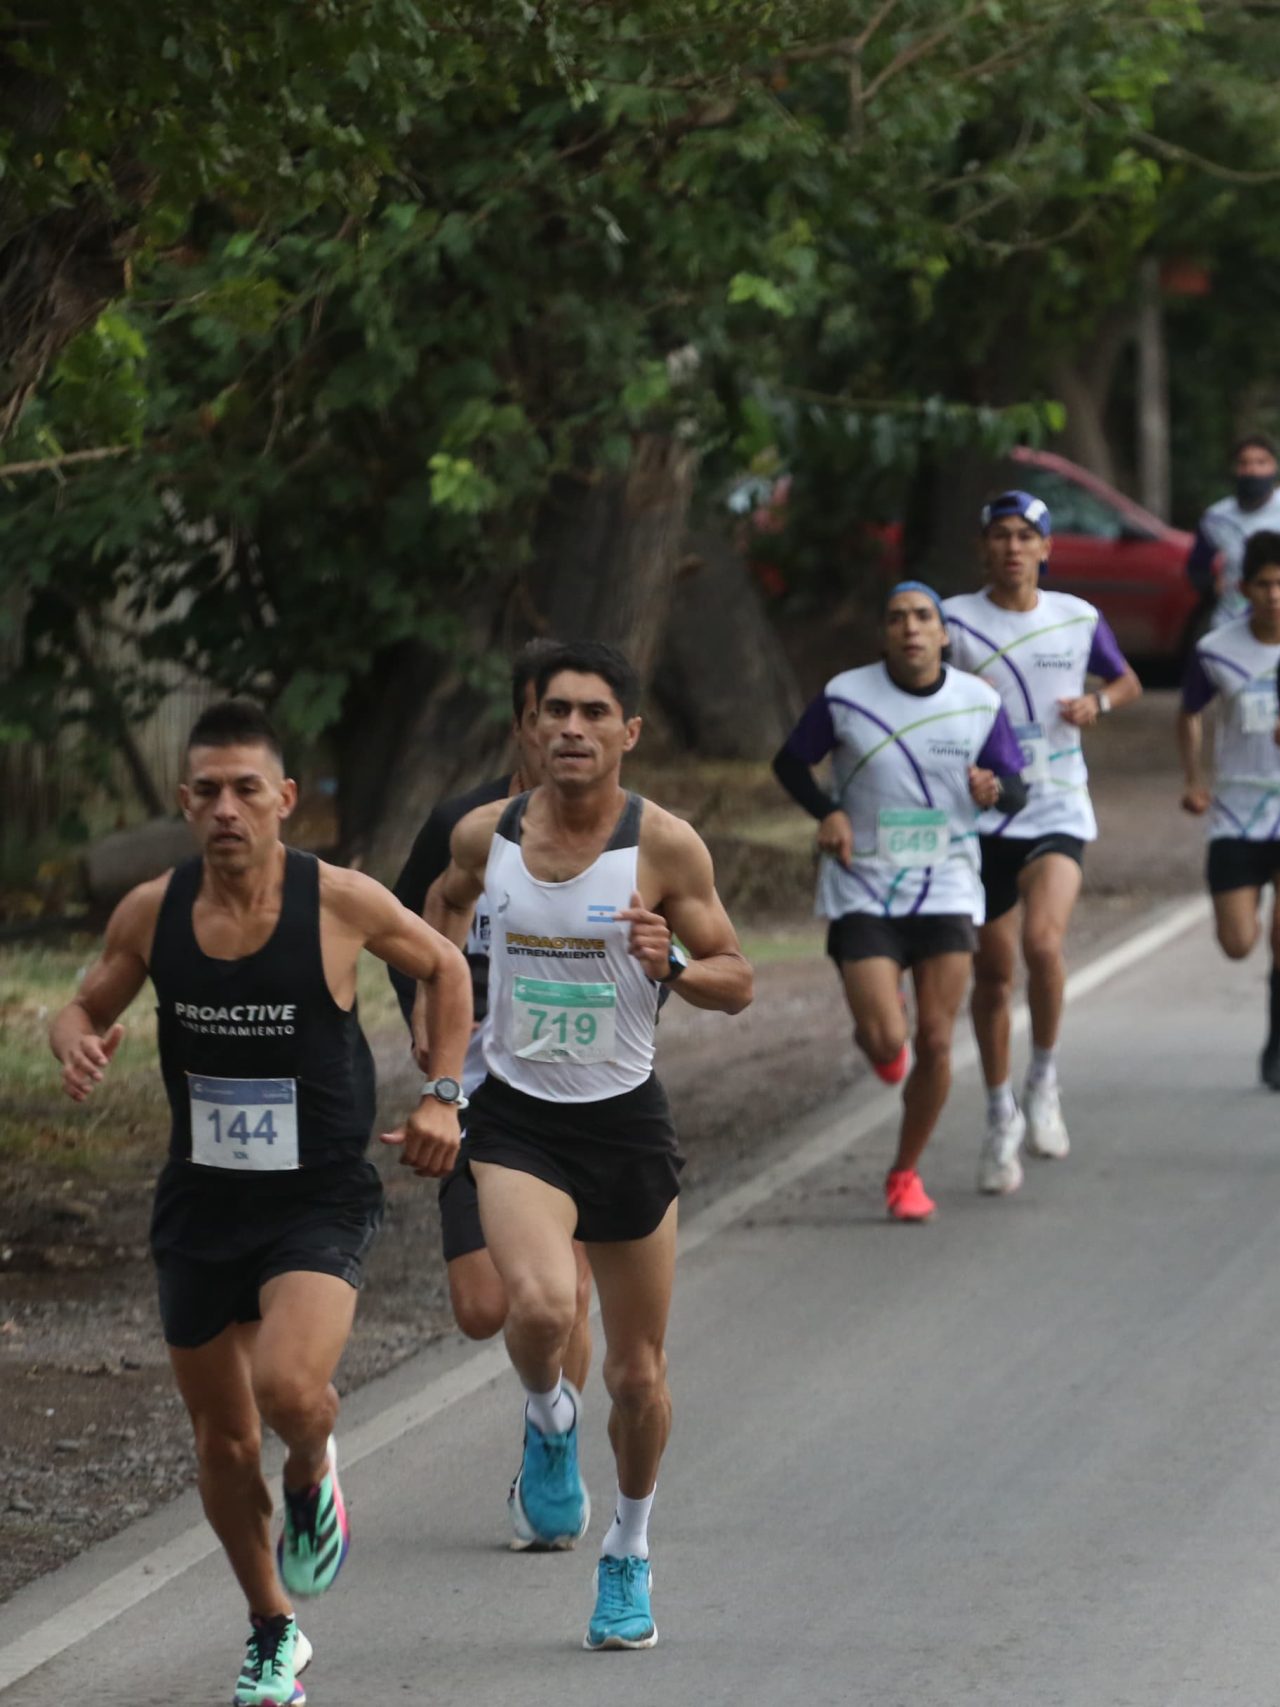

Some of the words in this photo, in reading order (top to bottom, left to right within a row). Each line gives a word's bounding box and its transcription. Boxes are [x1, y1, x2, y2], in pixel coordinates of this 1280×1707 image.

[505, 932, 606, 950] PROACTIVE
[507, 946, 606, 959] ENTRENAMIENTO
[174, 1002, 297, 1021] PROACTIVE
[527, 1007, 597, 1046] 719
[208, 1108, 278, 1146] 144
